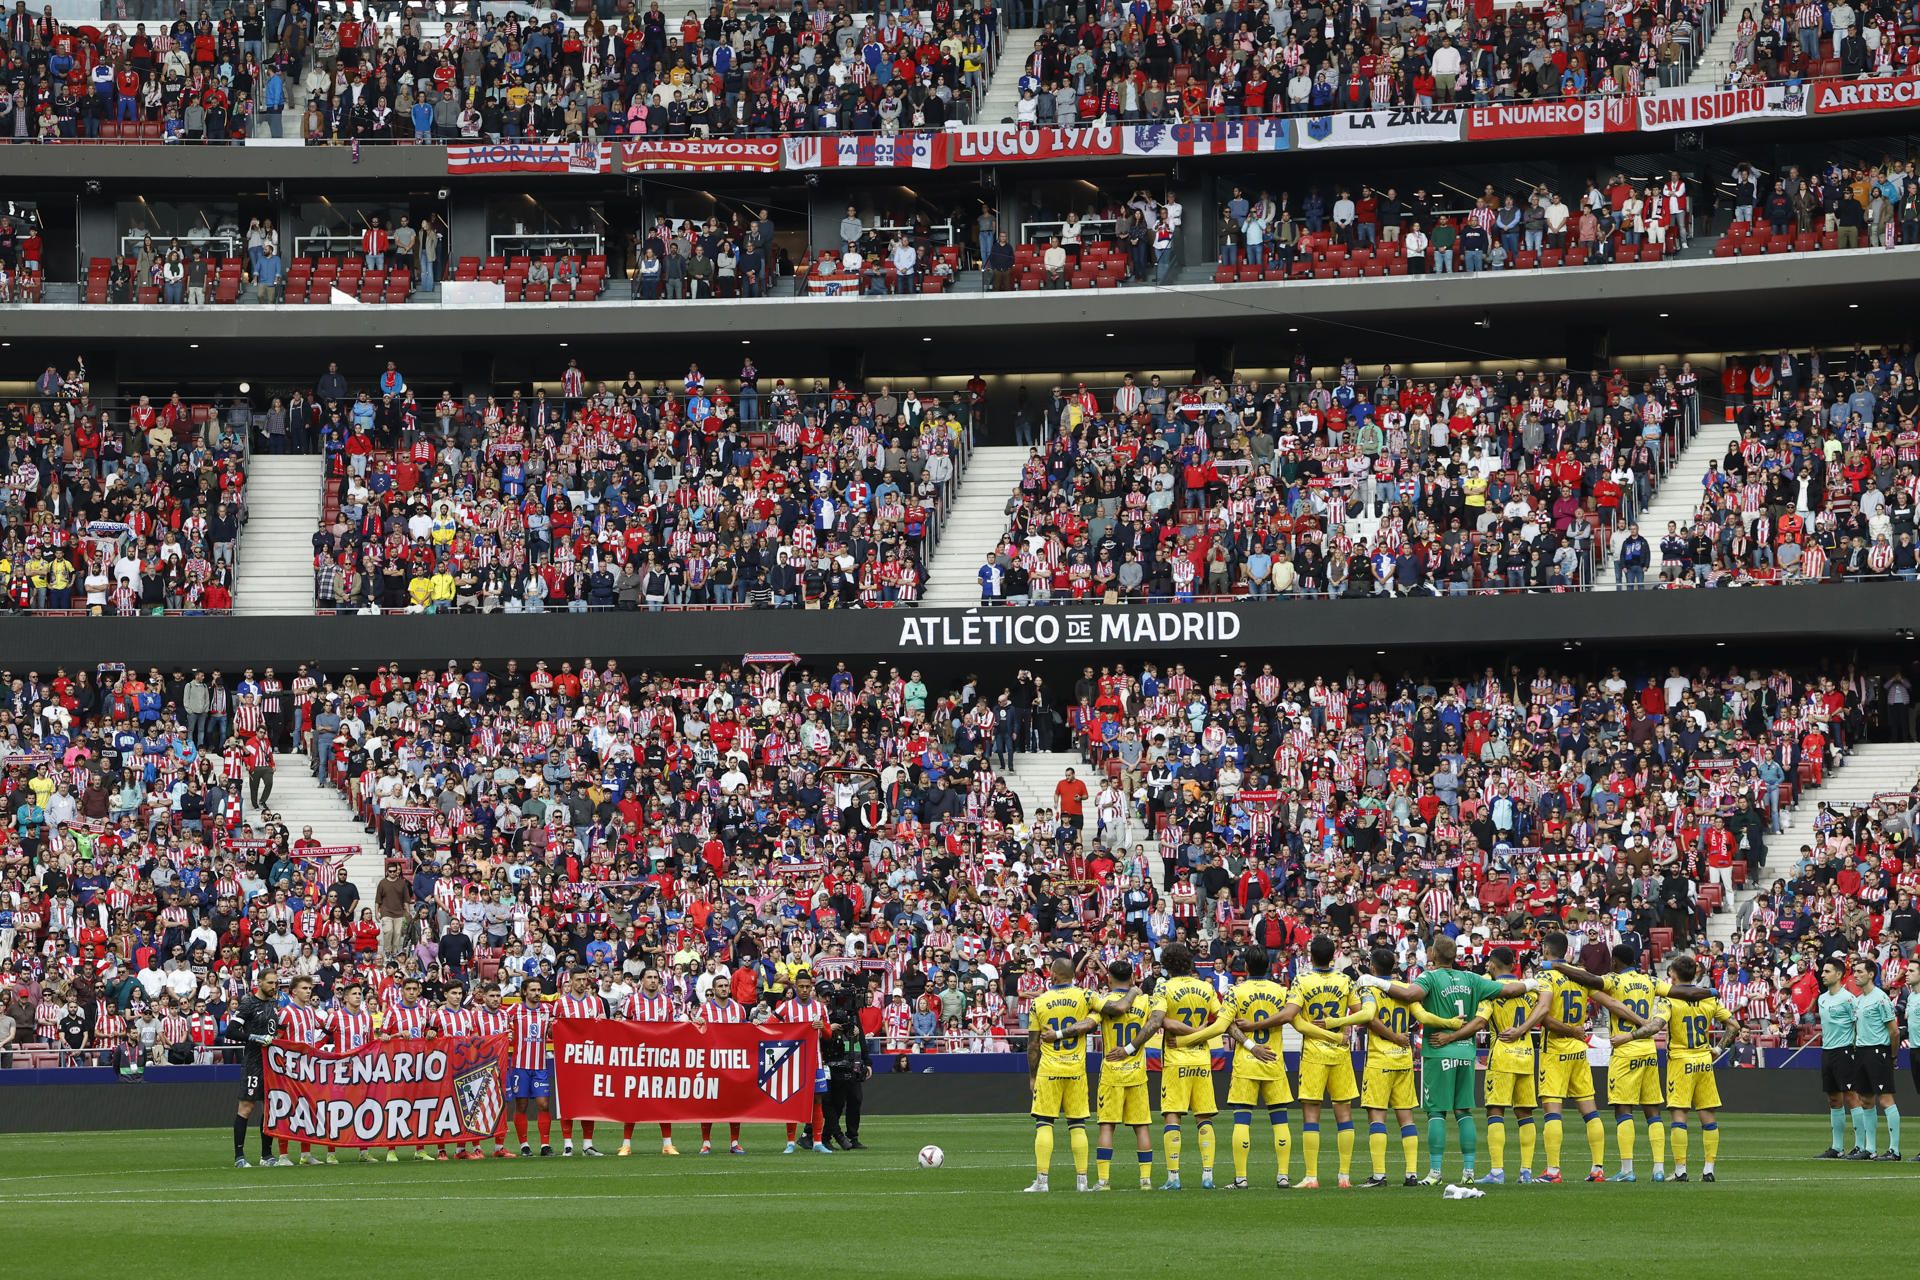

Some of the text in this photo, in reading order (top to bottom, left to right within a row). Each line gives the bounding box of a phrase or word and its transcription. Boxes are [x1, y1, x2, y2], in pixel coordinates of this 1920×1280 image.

[1350, 110, 1457, 129] LA ZARZA
[1473, 110, 1493, 127] EL
[1588, 102, 1601, 120] 3
[1643, 89, 1765, 126] SAN ISIDRO
[468, 145, 564, 165] MORALA
[623, 141, 779, 156] VALDEMORO
[834, 143, 927, 157] VALMOJADO
[959, 128, 1040, 157] LUGO
[899, 607, 1241, 646] ATLÉTICO DE MADRID
[1046, 998, 1078, 1010] SANDRO
[1191, 986, 1211, 1003] SILVA
[1303, 986, 1323, 1003] ALEX
[1560, 989, 1583, 1024] 15
[1454, 999, 1467, 1018] 1
[1512, 1006, 1526, 1041] 4
[1682, 1014, 1708, 1049] 18
[1112, 1022, 1142, 1056] 10
[267, 1044, 448, 1086] CENTENARIO
[564, 1040, 751, 1070] PEÑA ATLÉTICA DE UTIEL
[247, 1075, 259, 1088] 13
[513, 1074, 520, 1087] 7
[1178, 1065, 1211, 1078] Binter
[593, 1071, 720, 1101] EL PARADÓN
[267, 1089, 461, 1142] PAIPORTA
